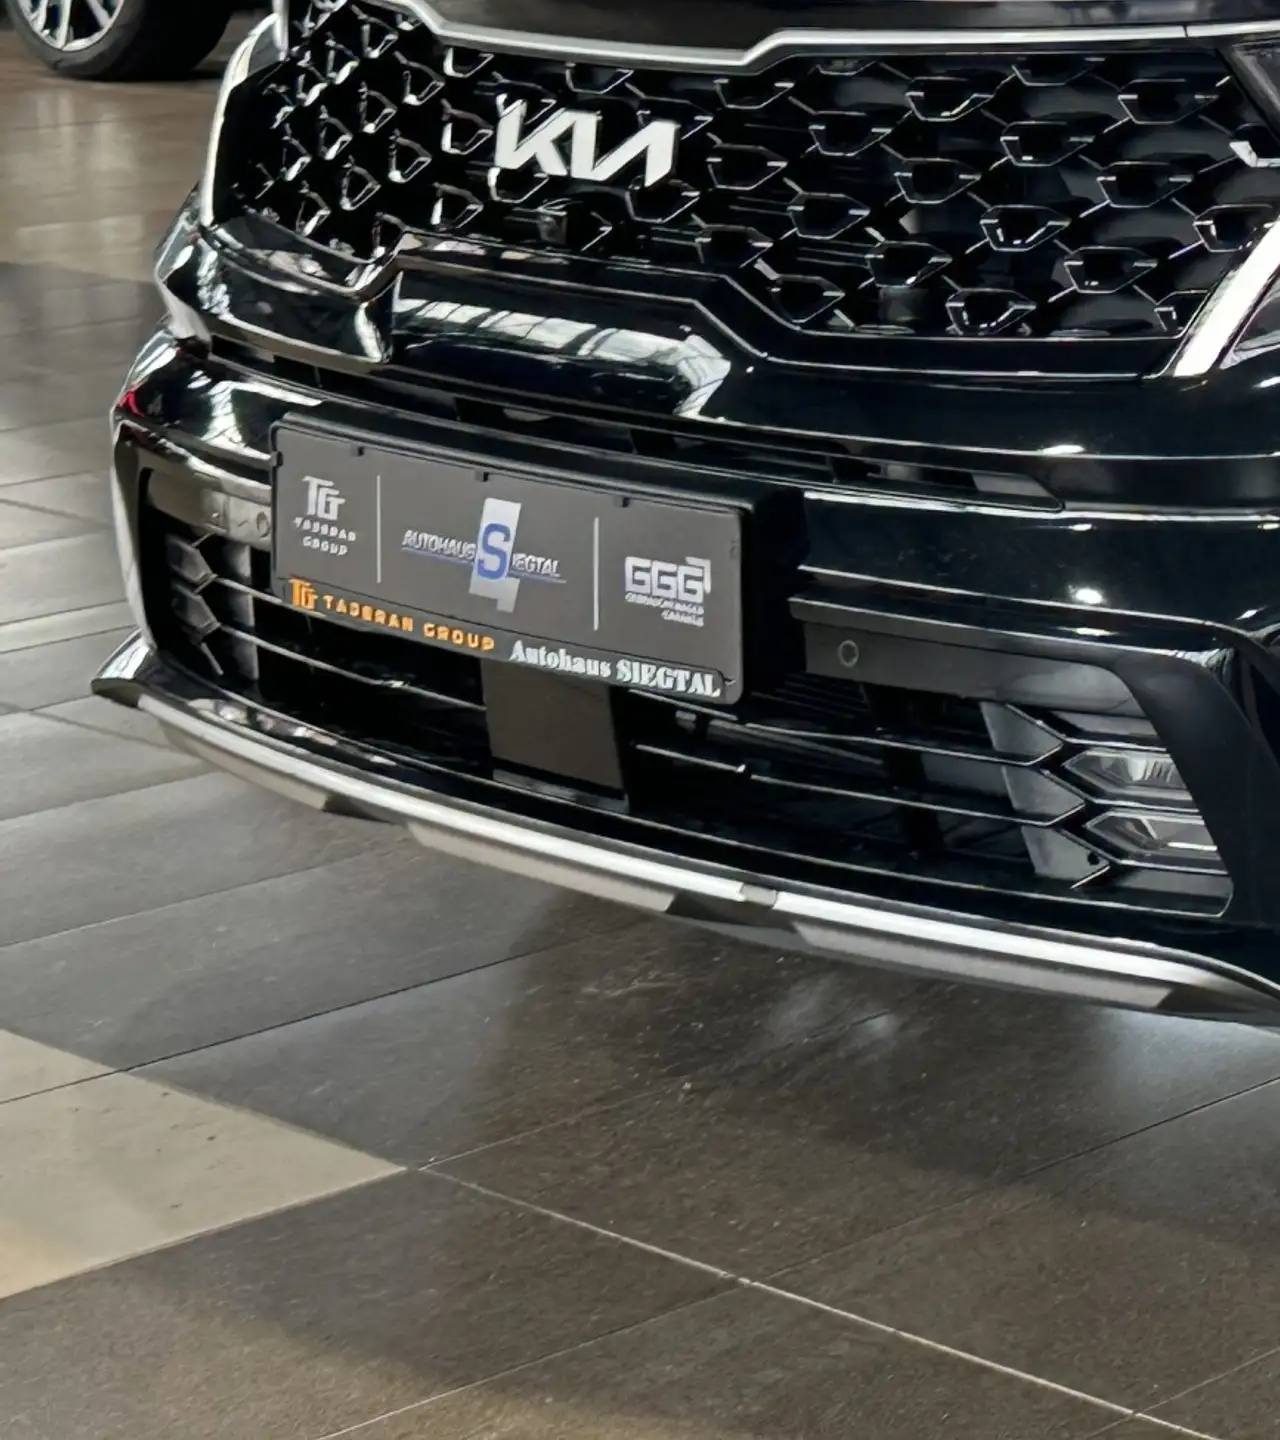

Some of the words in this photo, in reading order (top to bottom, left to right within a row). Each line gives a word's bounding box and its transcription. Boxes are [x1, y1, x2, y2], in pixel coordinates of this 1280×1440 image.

[494, 98, 682, 188] KIA
[302, 536, 348, 556] GROUP
[401, 529, 476, 561] AUTOHAUS
[624, 556, 706, 604] GGG
[423, 622, 495, 651] GROUP
[509, 639, 612, 679] Autohaus
[615, 658, 722, 698] SIEGTAL
